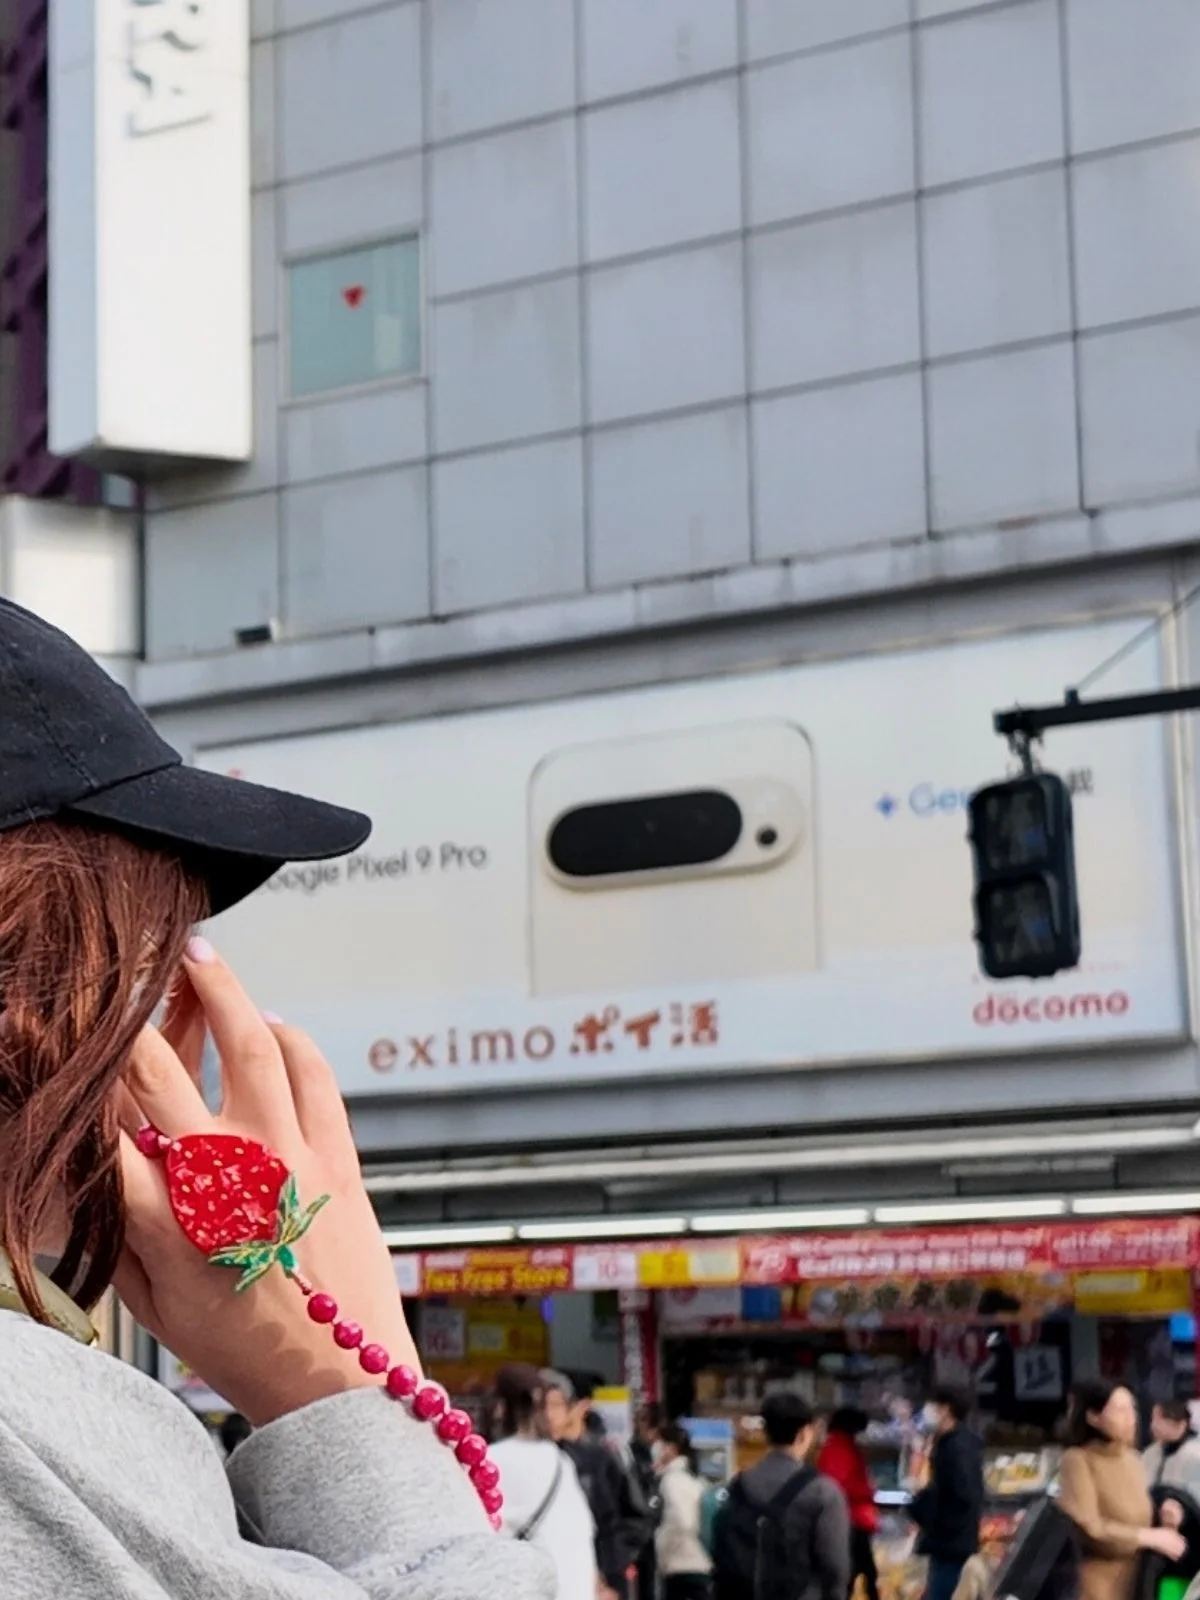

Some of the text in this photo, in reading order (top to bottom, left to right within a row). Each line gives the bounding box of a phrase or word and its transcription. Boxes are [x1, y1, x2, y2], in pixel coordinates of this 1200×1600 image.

[265, 841, 488, 896] oogle Pixel 9 Pro
[972, 990, 1130, 1027] docomo
[367, 1007, 557, 1074] eximo
